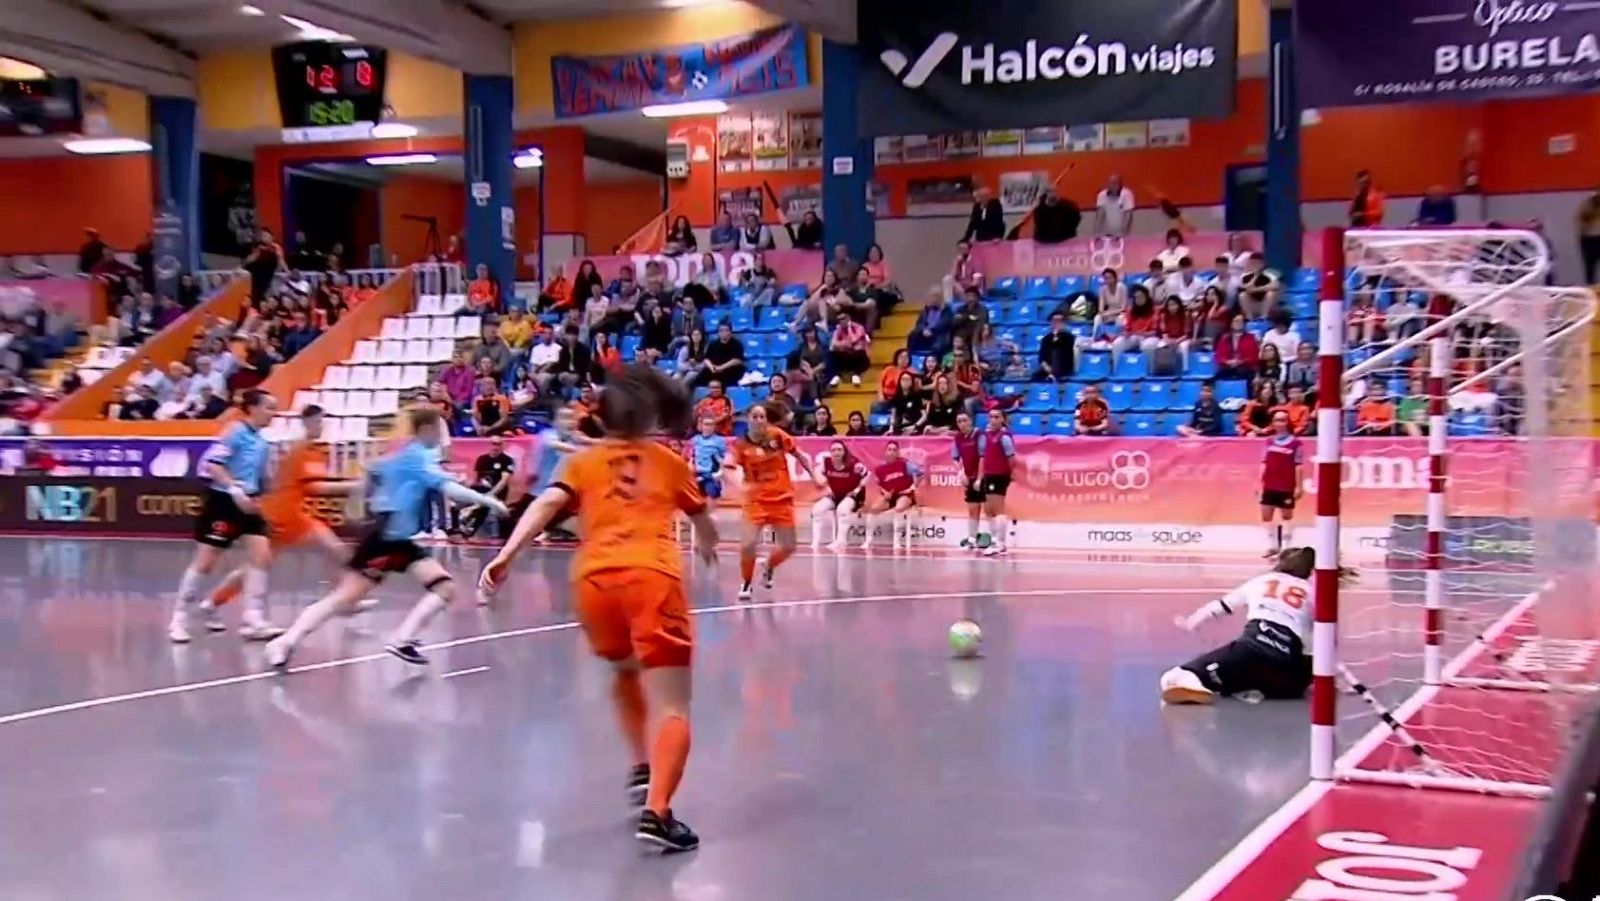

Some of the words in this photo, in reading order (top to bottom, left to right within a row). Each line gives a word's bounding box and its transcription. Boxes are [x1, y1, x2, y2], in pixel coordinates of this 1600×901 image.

[961, 34, 1127, 85] Halcón
[1132, 43, 1216, 75] viajes
[1434, 34, 1600, 76] BURELA
[1064, 471, 1111, 487] LUGO
[25, 485, 118, 523] NB21
[1263, 580, 1307, 609] 18
